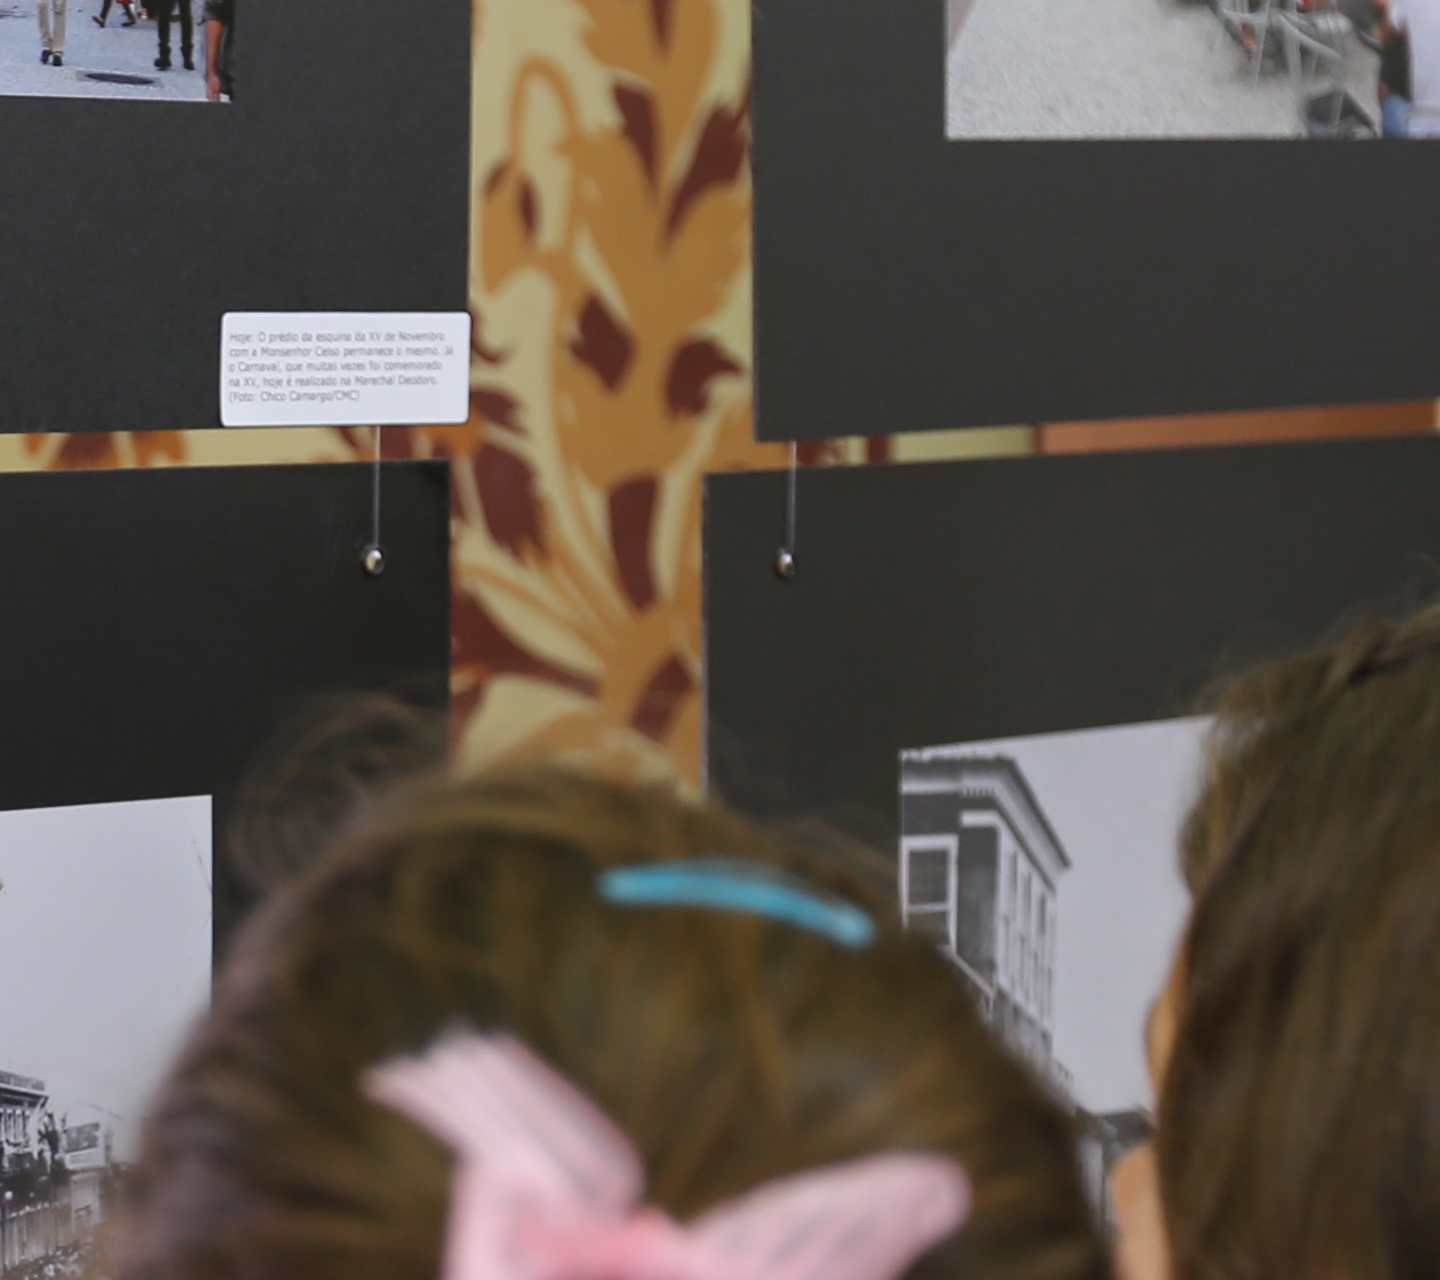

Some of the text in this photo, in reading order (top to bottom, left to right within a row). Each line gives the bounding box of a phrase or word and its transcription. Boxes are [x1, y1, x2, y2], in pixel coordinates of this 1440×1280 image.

[258, 331, 267, 342] O
[269, 331, 299, 344] prédio
[316, 332, 352, 343] esquina
[354, 332, 366, 342] da
[369, 332, 382, 341] XV
[384, 332, 396, 342] de
[398, 331, 445, 342] Novembro
[229, 348, 249, 357] com
[251, 348, 258, 357] a
[261, 346, 312, 357] Monsenhor
[315, 346, 340, 357] Celso
[343, 347, 394, 358] permanece
[396, 347, 403, 356] o
[405, 346, 440, 356] mesmo.
[229, 360, 442, 373] o Carnaval, que muitas vezes foi comemorado
[229, 377, 240, 387] na
[263, 376, 284, 389] hoje
[286, 375, 293, 387] é
[296, 375, 338, 387] realizado
[340, 377, 352, 386] na
[354, 375, 395, 386] Marechal
[398, 375, 439, 386] Deodoro.
[229, 389, 361, 404] (Foto: Chico Camargo/CMC)
